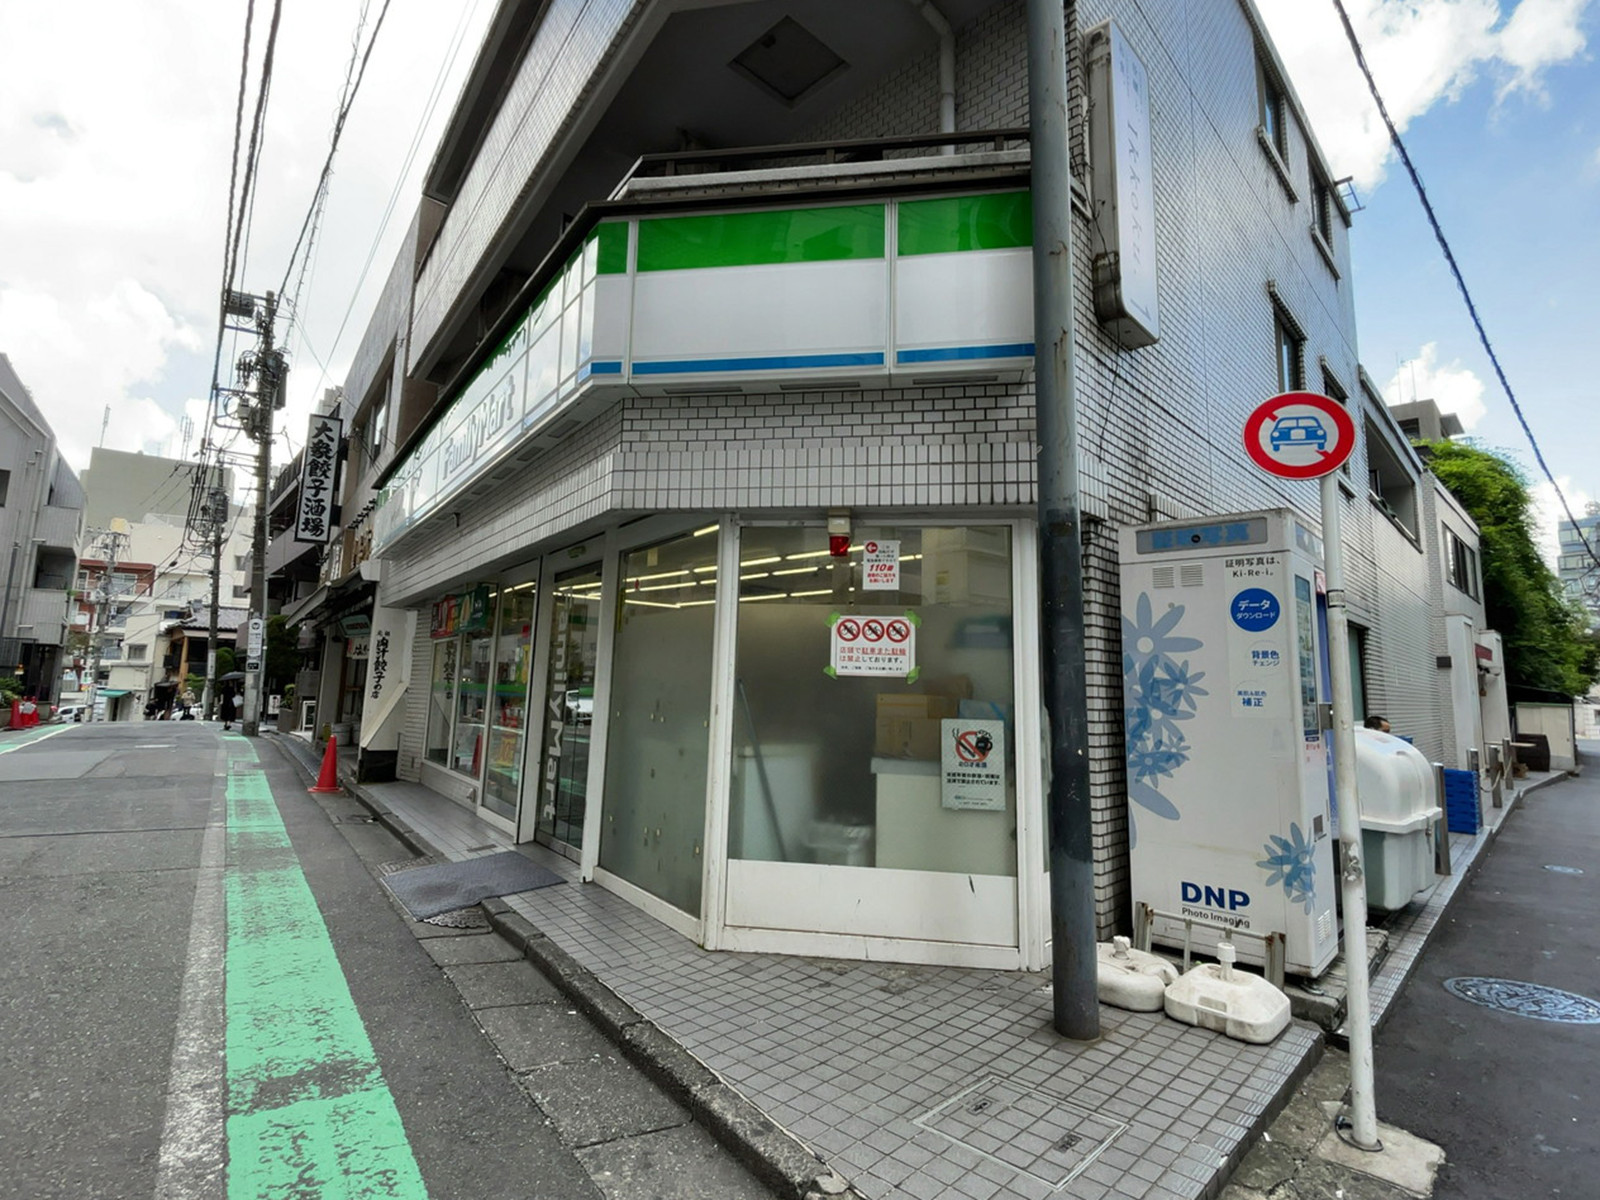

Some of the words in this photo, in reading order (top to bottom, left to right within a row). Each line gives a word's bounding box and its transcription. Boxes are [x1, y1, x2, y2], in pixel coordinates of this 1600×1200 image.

[442, 374, 516, 481] FamilyMart
[300, 420, 336, 538] 大衆餃子酒場
[1225, 556, 1281, 568] 証明写真は、
[1238, 599, 1271, 611] データ
[1236, 611, 1276, 620] ダウンロード
[1251, 650, 1280, 659] 背景色
[1252, 659, 1280, 667] チェンジ
[370, 637, 390, 699] 肉汁餃子の店
[543, 597, 572, 820] FamilyMart
[1242, 697, 1264, 707] 補正
[1181, 881, 1251, 911] DNP
[1181, 907, 1209, 920] Photo
[1210, 912, 1251, 929] Imaging
